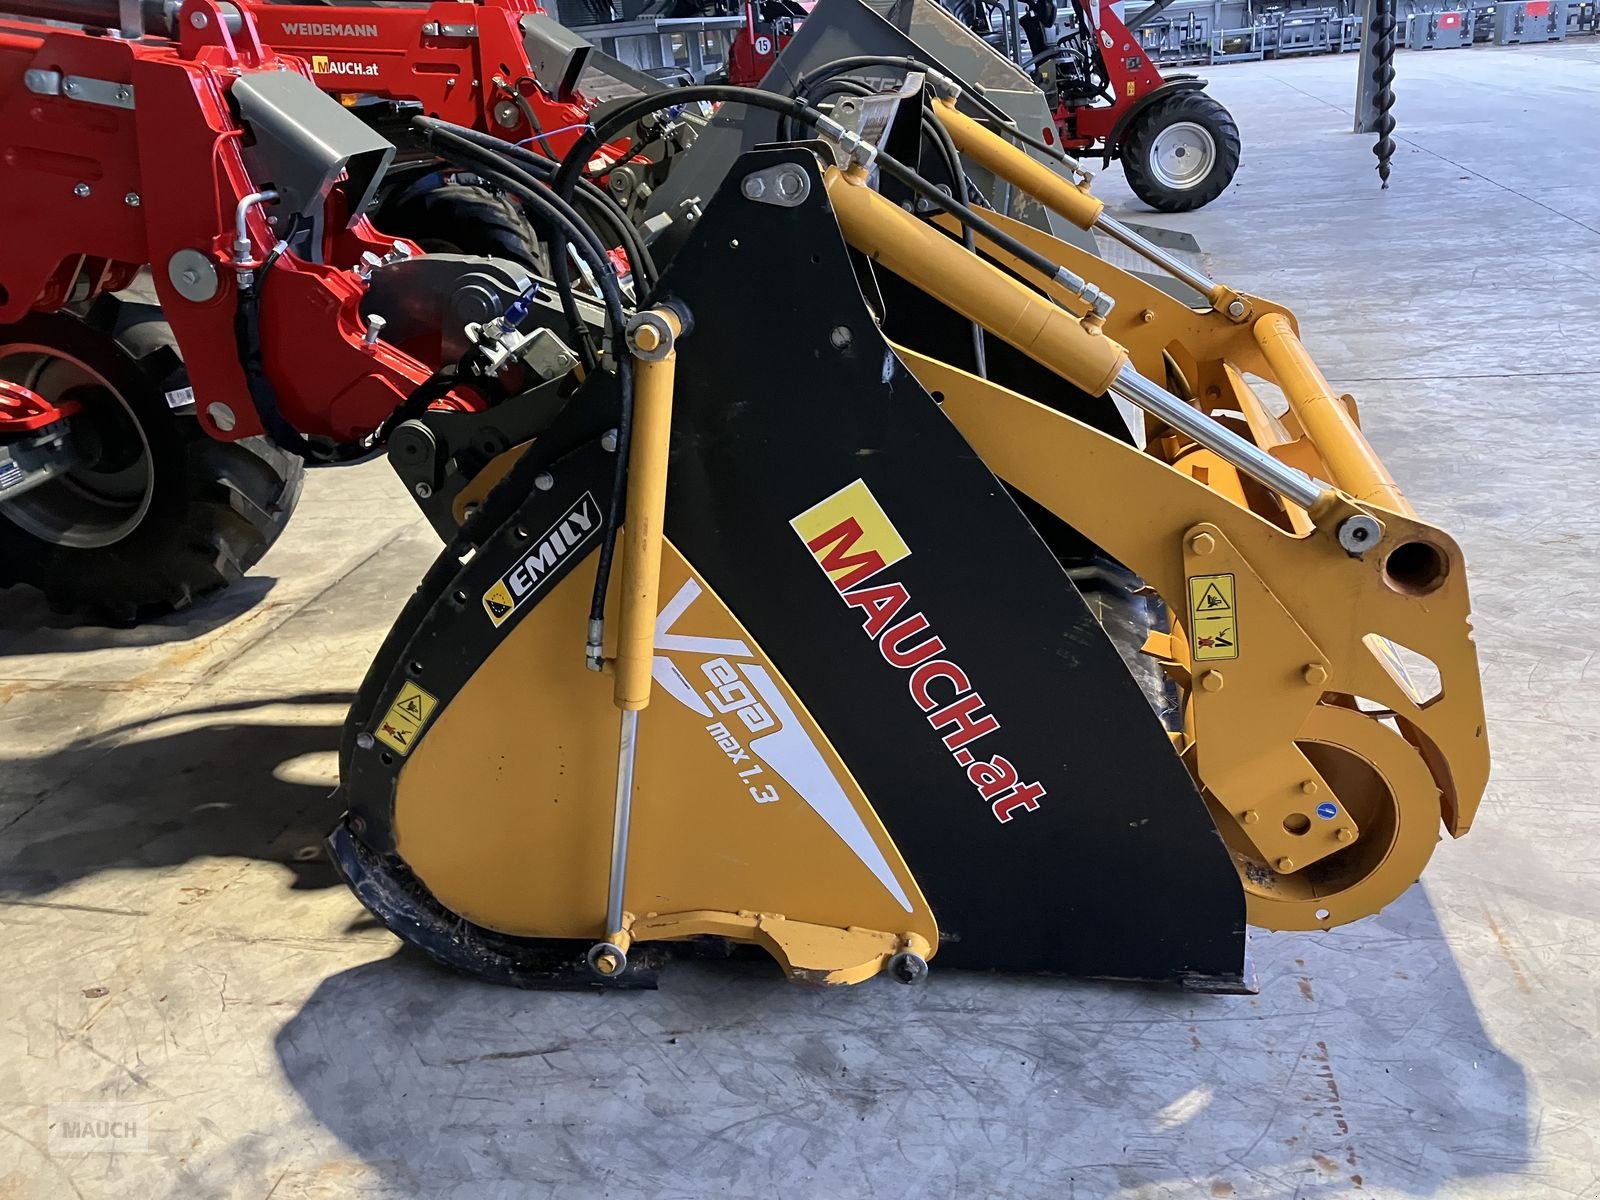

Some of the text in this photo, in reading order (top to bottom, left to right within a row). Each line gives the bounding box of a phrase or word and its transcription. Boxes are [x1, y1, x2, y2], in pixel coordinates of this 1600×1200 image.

[280, 22, 379, 37] WEIDEMANN
[758, 39, 769, 52] 15
[508, 500, 592, 597] EMILY
[653, 576, 775, 733] Vega
[805, 514, 1047, 824] MAUCH.at
[704, 721, 780, 805] max 1.3
